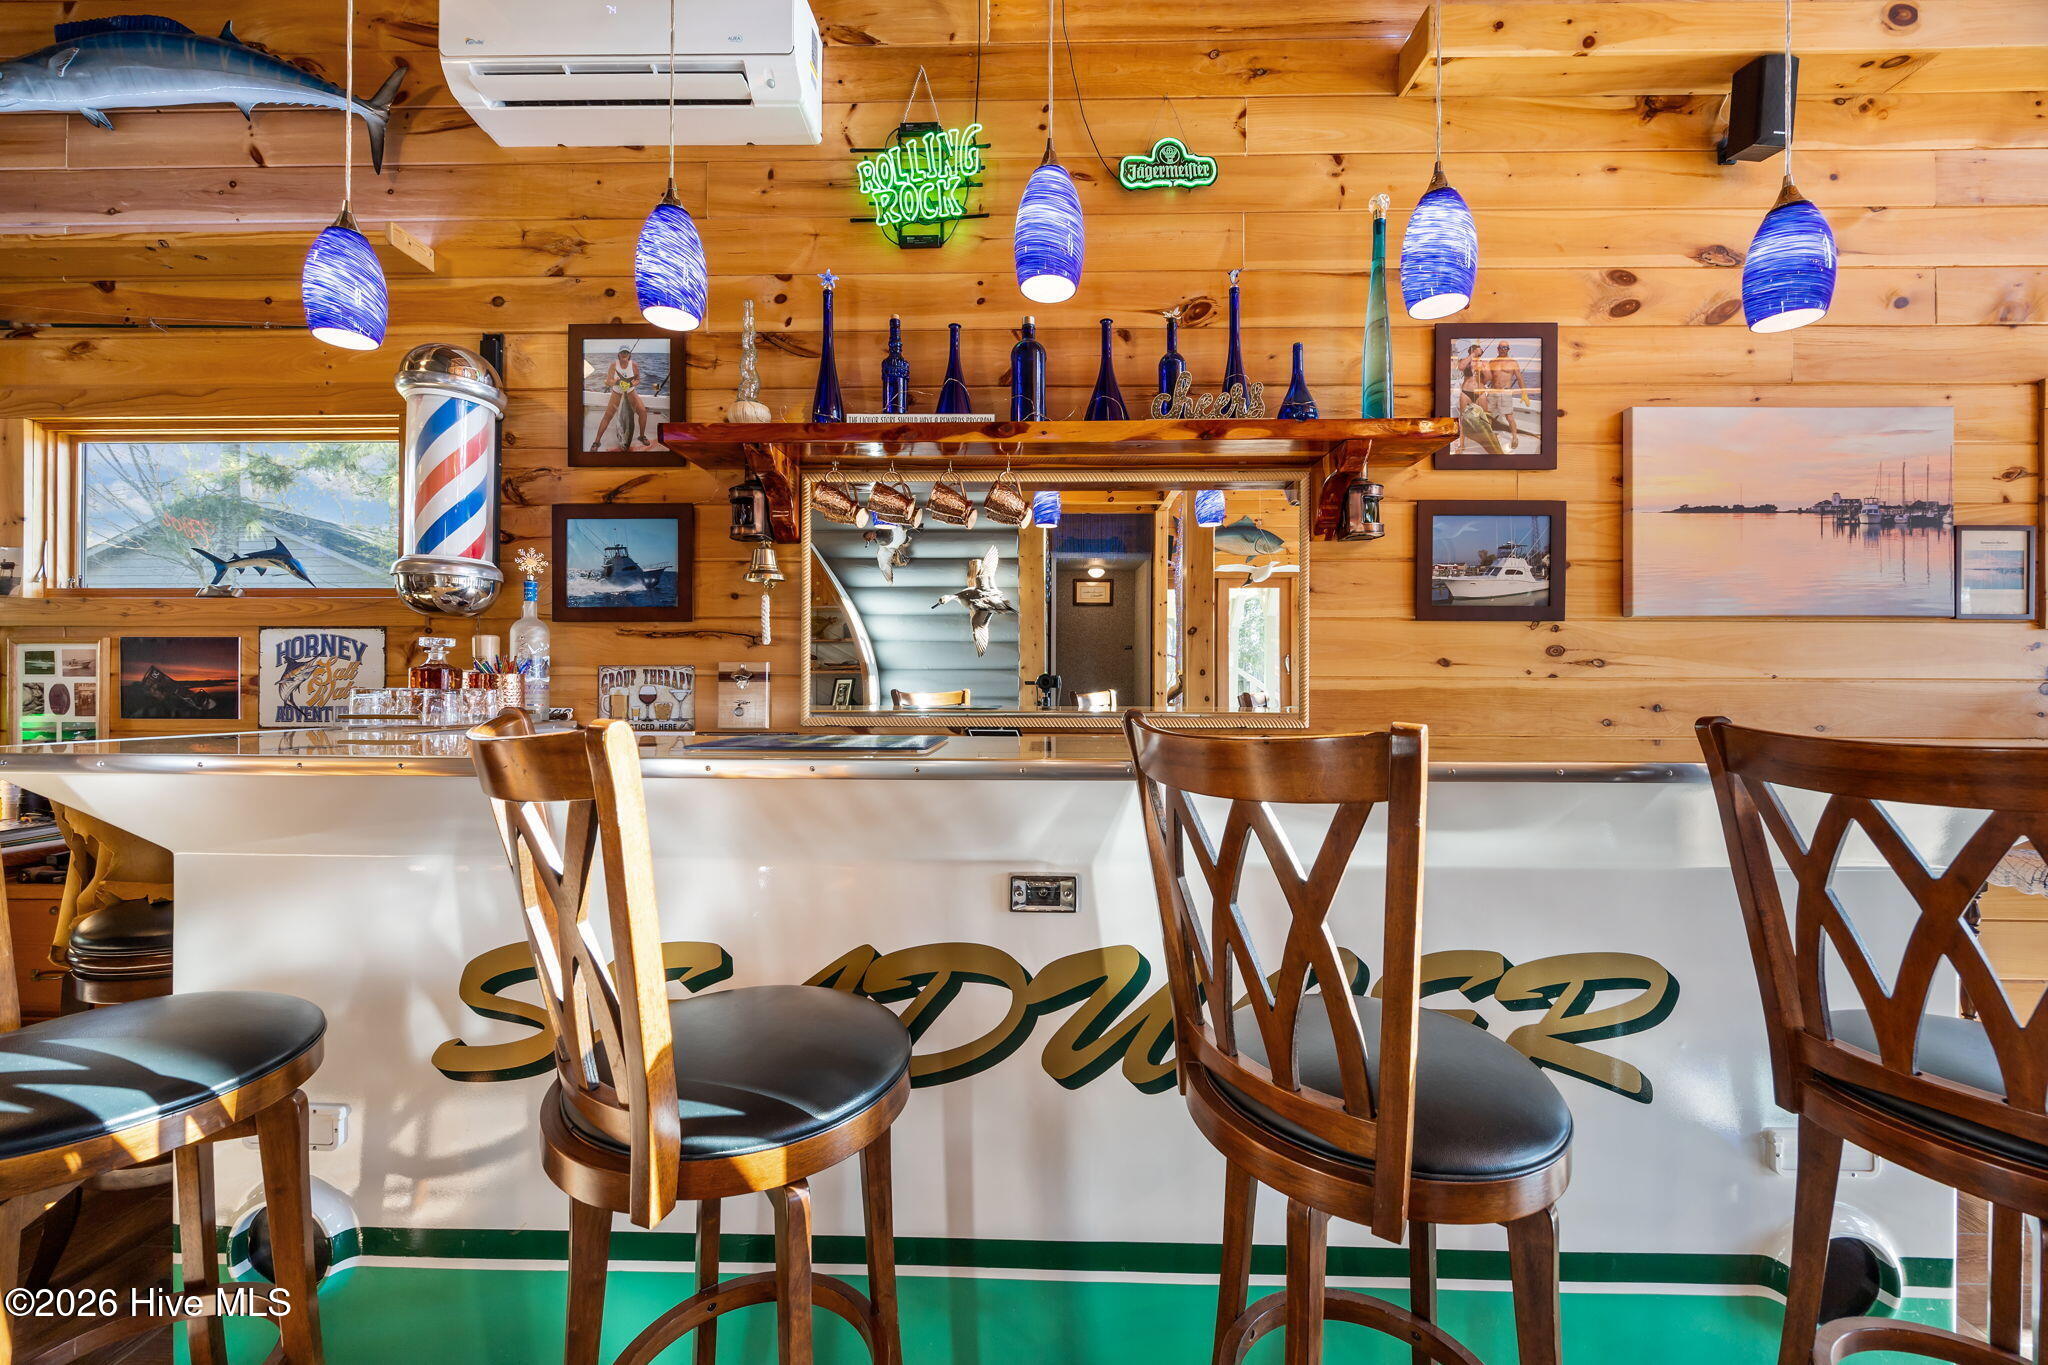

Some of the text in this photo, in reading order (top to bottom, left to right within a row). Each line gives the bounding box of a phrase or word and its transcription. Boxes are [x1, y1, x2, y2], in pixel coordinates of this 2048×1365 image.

[857, 124, 983, 194] ROLLING
[1127, 162, 1210, 181] Jägermeister
[872, 176, 963, 226] ROCK
[1151, 371, 1265, 420] cheers
[275, 633, 368, 668] HORNEY
[601, 669, 692, 695] GROUP THERAPY
[630, 723, 677, 731] CTICED HERE
